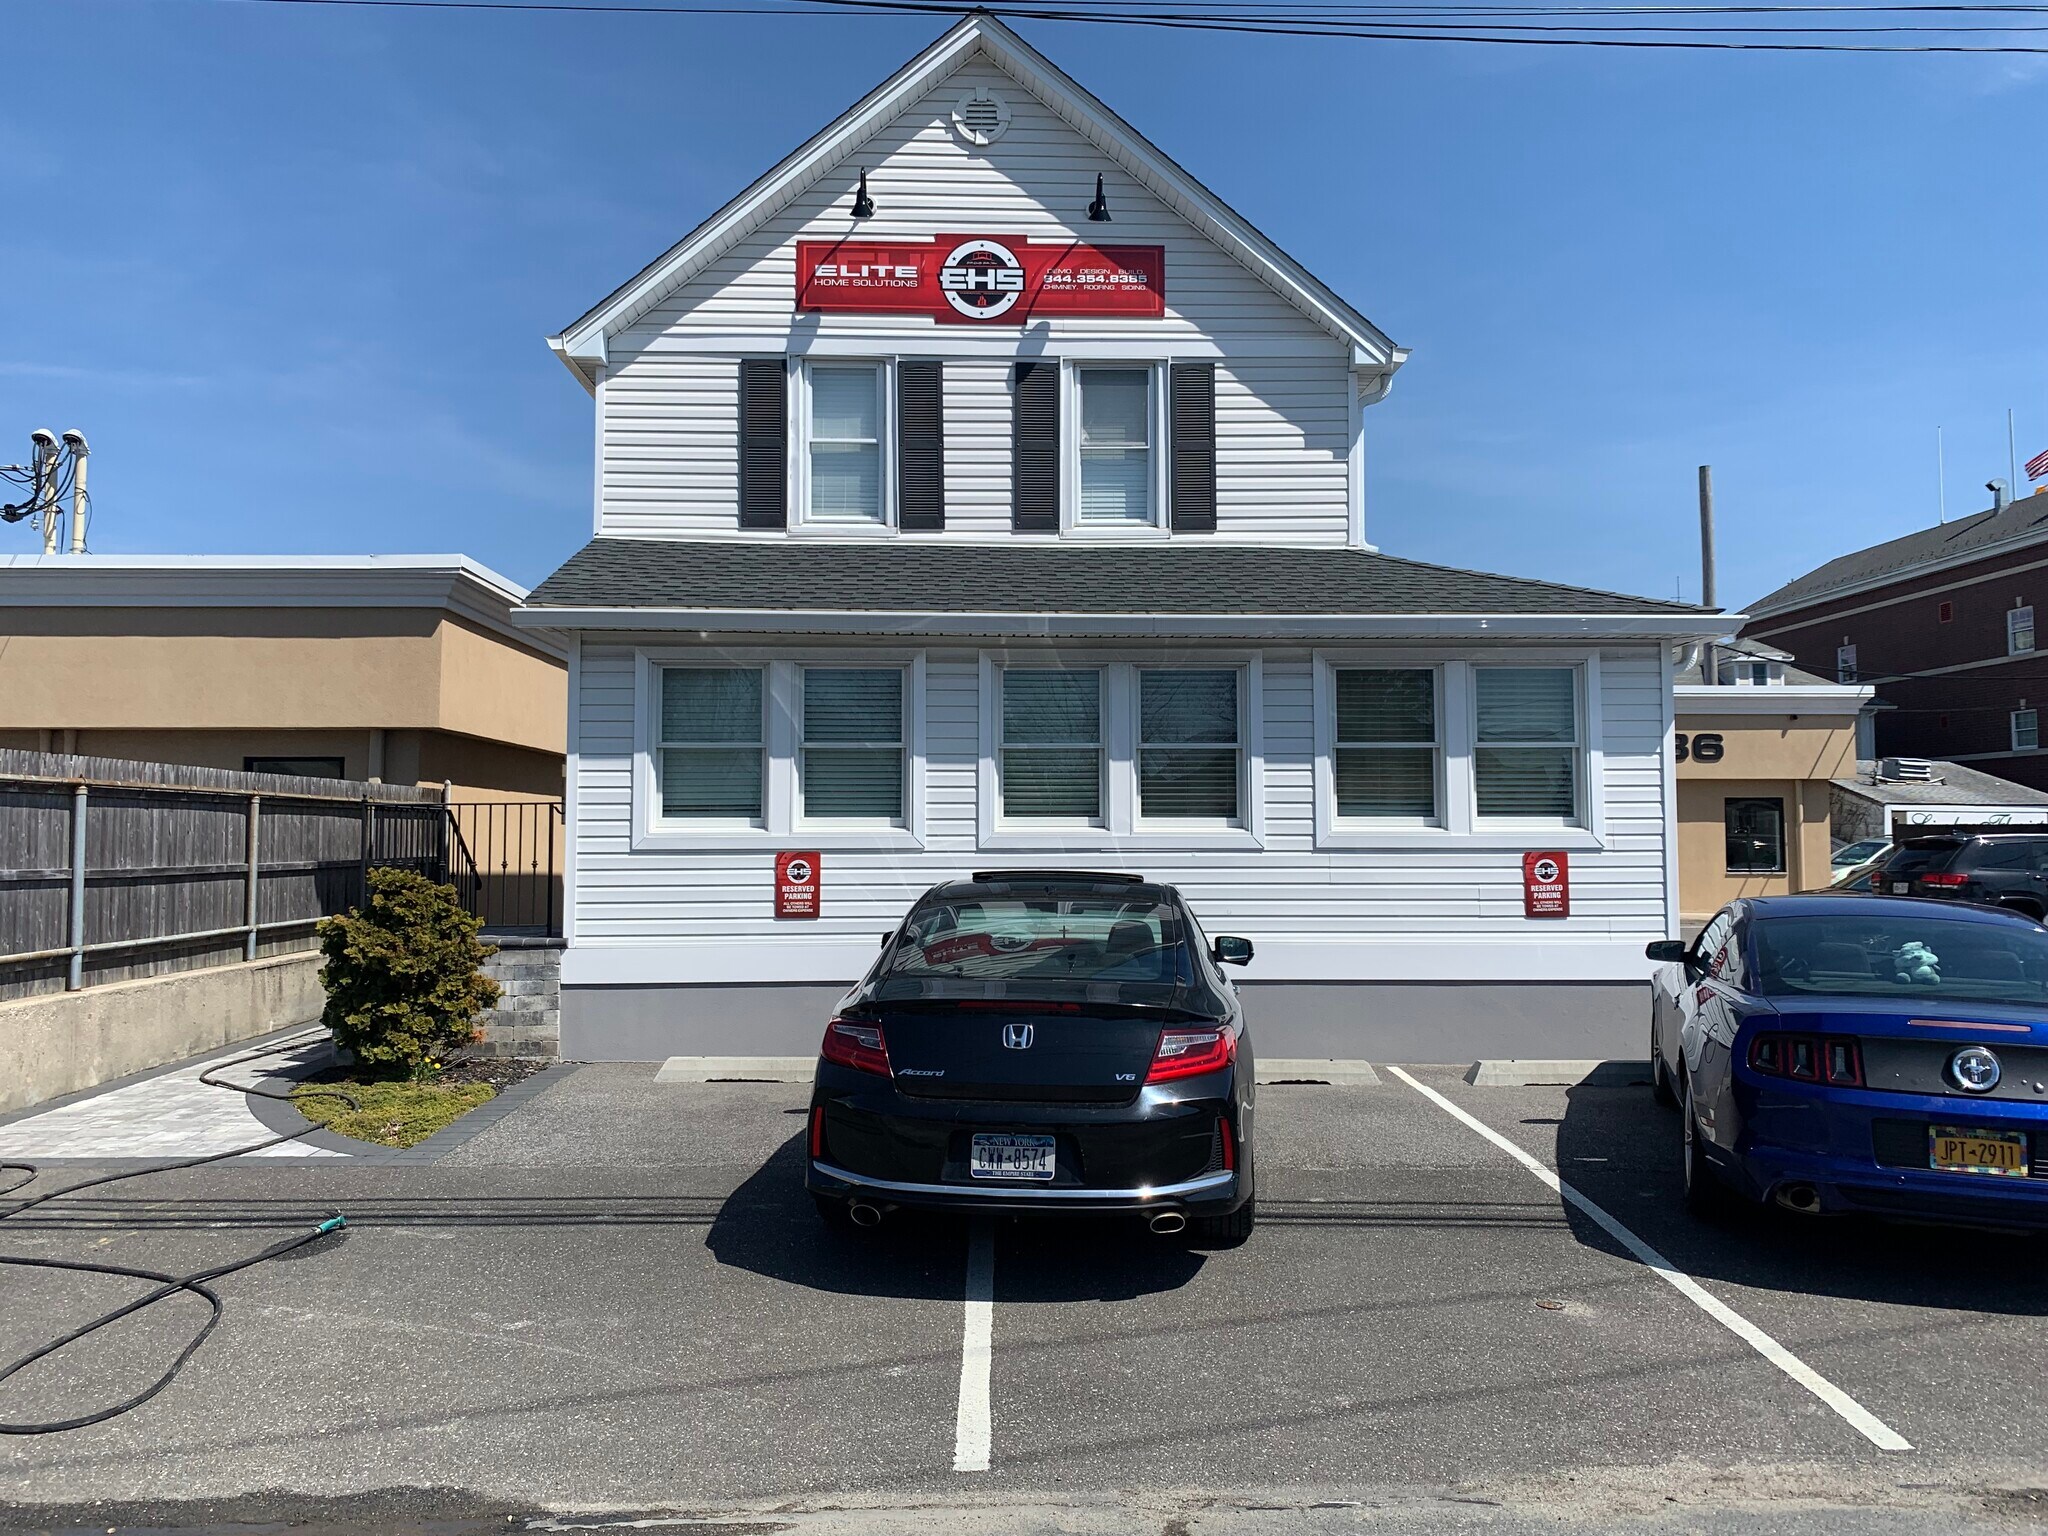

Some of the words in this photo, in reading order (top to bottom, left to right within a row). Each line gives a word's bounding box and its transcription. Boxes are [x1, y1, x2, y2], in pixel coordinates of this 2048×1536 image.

[814, 264, 918, 278] ELITE
[814, 278, 850, 287] HOME
[852, 279, 918, 288] SOLUTIONS
[939, 268, 1024, 290] EHS
[786, 868, 812, 876] EHS
[1534, 867, 1559, 875] EHS
[781, 885, 815, 893] RESERVED
[1530, 884, 1564, 892] RESERVED
[784, 892, 813, 900] PARKING
[1533, 891, 1562, 899] PARKING
[897, 1068, 945, 1077] Accord
[1115, 1073, 1136, 1081] V6
[993, 1137, 1011, 1146] NEW
[1014, 1137, 1035, 1147] YORK
